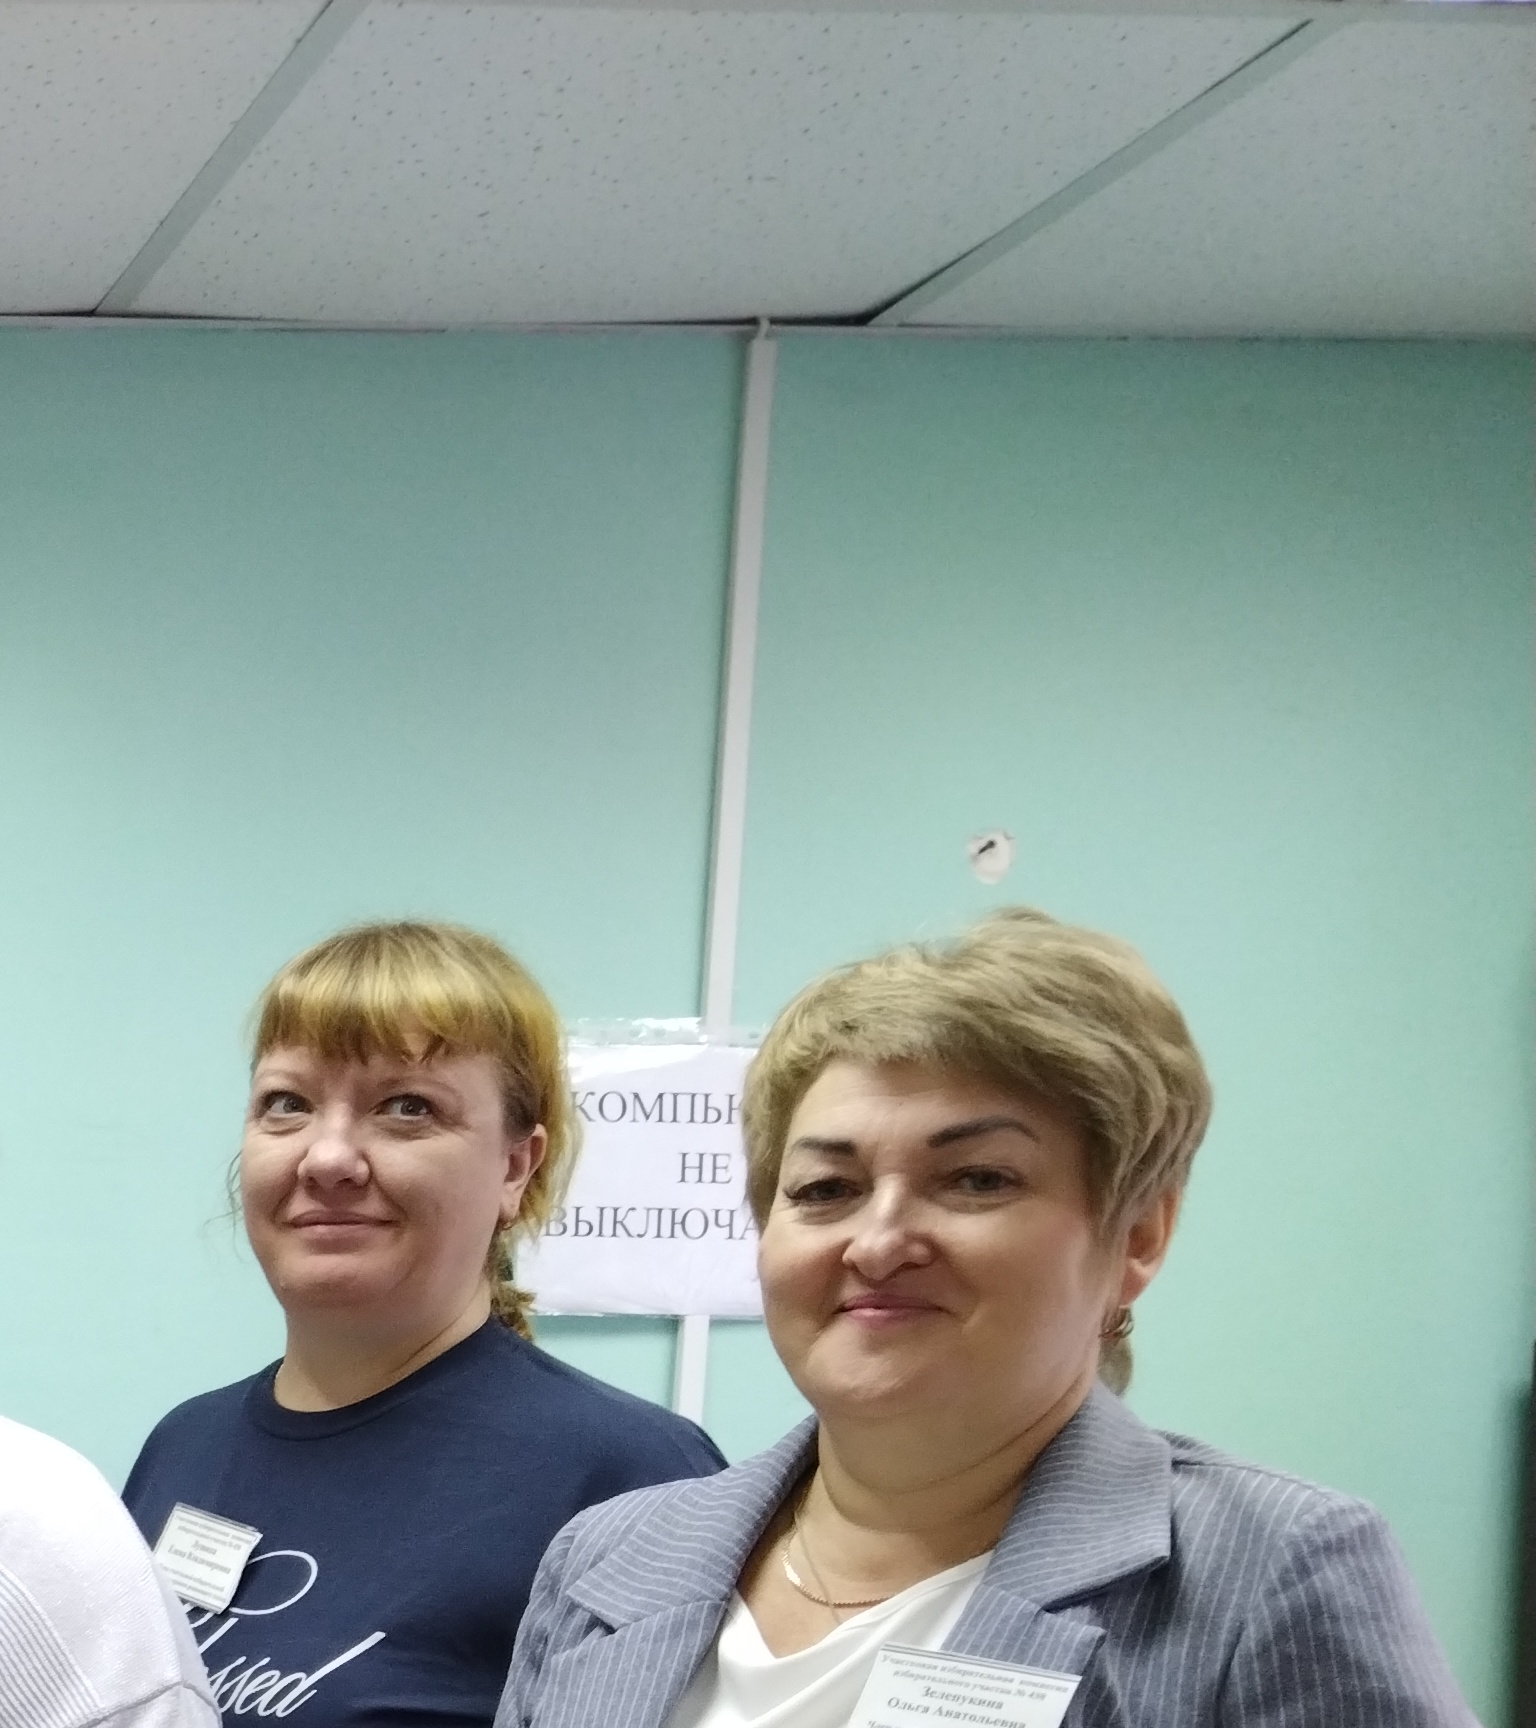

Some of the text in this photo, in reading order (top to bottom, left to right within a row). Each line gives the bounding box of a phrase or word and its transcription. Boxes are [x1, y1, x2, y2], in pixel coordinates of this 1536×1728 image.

[571, 1091, 742, 1125] КОМПЬ
[677, 1152, 732, 1184] НЕ
[887, 1697, 930, 1714] Ольга
[922, 1686, 1004, 1710] Зелепукина
